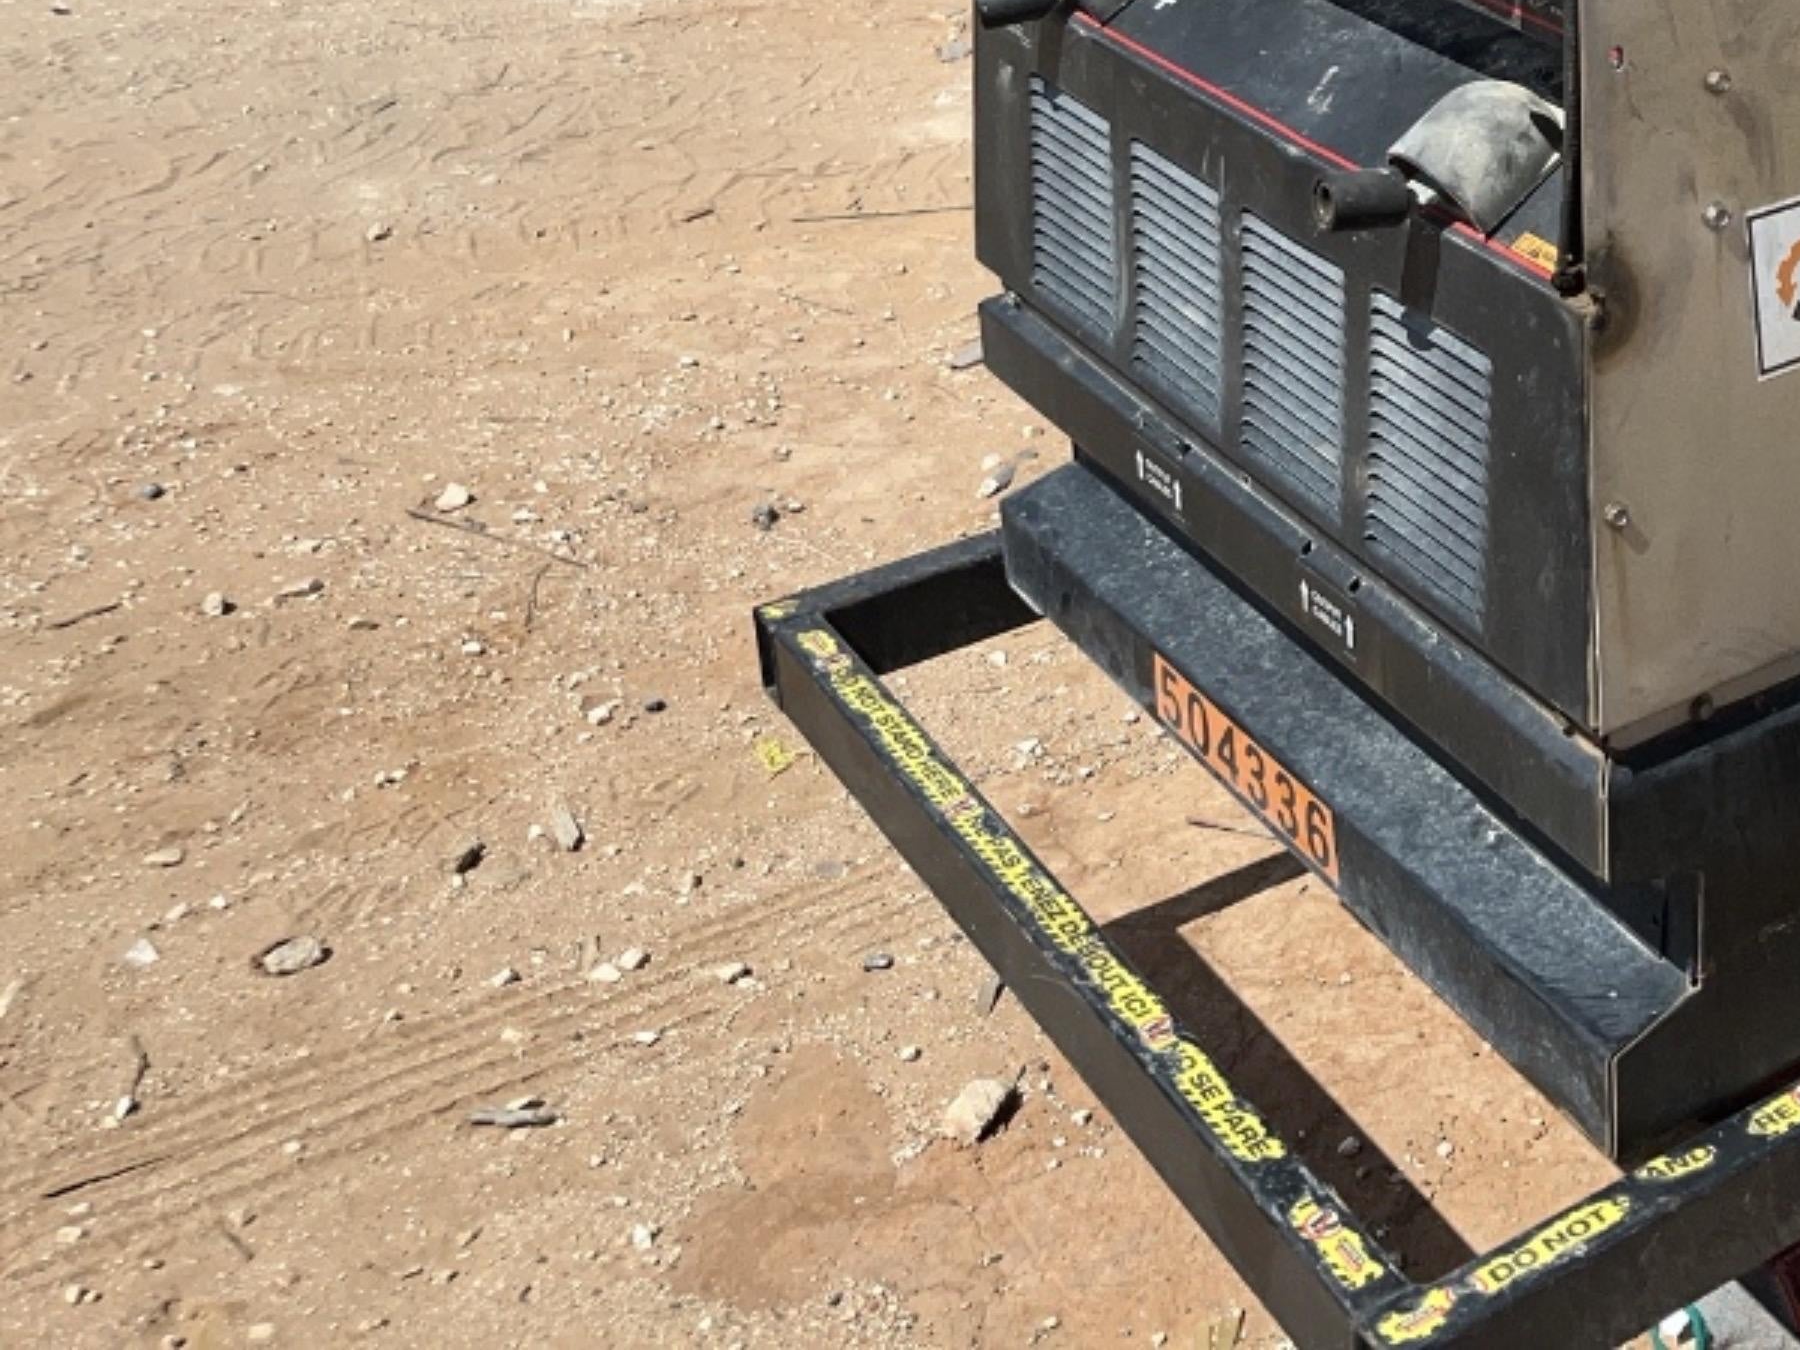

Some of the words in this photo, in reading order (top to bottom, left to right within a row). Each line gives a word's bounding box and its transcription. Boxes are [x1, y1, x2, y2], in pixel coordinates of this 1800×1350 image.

[853, 685, 886, 713] NOT
[874, 712, 926, 760] STAND
[1160, 665, 1330, 868] 504336
[1117, 991, 1153, 1019] ICI
[1189, 1073, 1226, 1102] SE
[1487, 1248, 1540, 1284] DO
[1540, 1204, 1609, 1254] NOT
